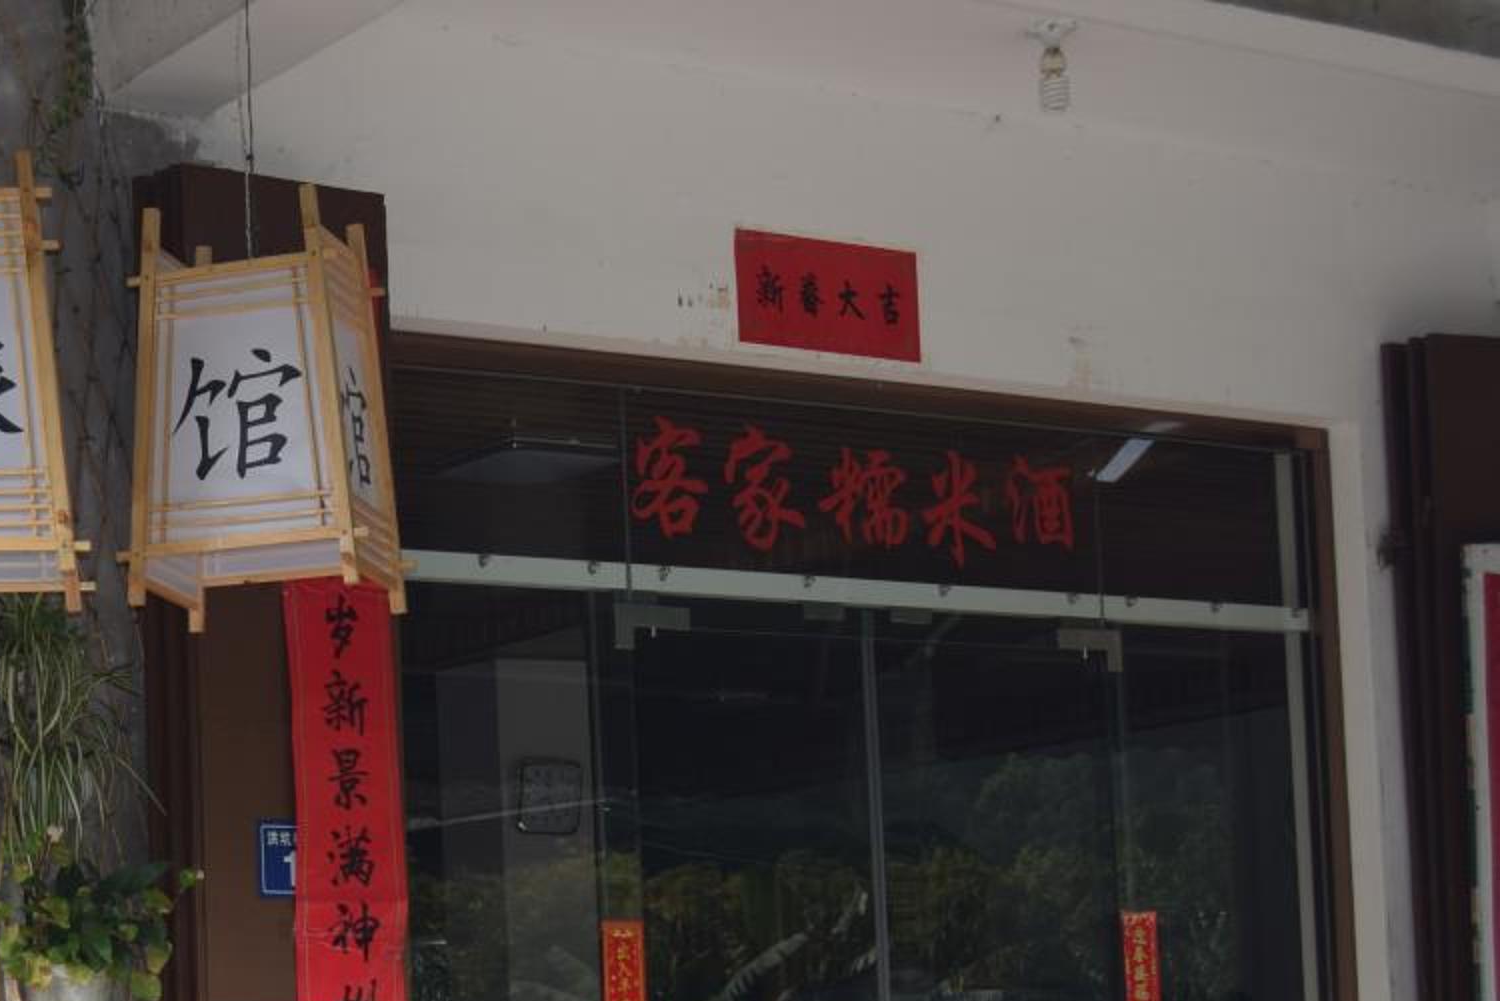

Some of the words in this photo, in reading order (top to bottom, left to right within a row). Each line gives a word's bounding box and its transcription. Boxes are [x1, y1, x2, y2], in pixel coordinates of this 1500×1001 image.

[755, 263, 901, 326] 新春大吉
[173, 348, 303, 481] 馆
[630, 415, 1076, 569] 客家糯米酒
